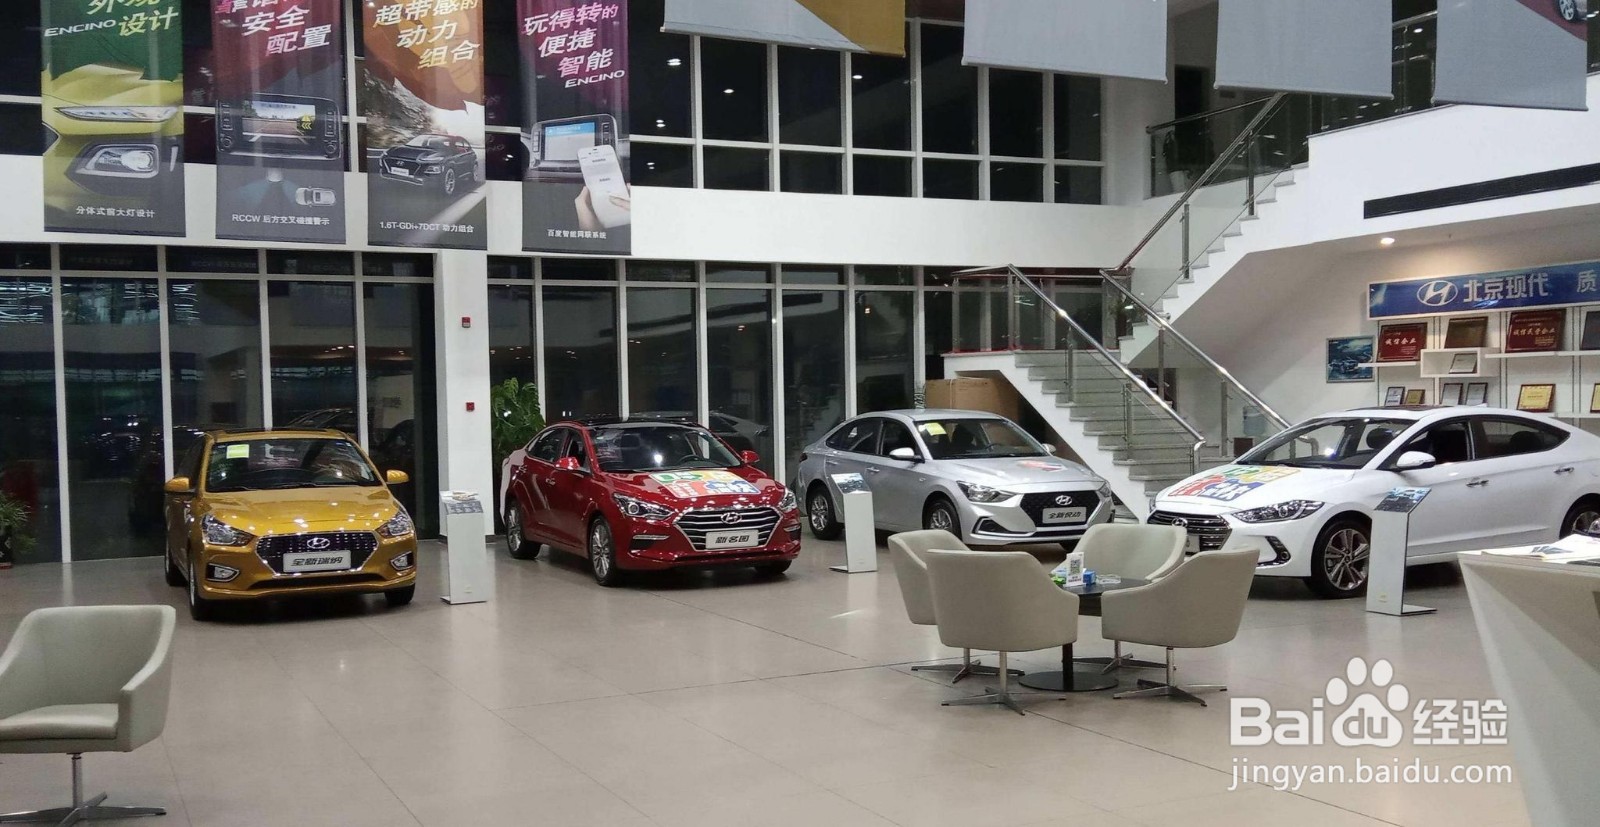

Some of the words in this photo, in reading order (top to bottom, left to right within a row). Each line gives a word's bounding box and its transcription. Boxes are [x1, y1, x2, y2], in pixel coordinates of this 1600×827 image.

[44, 19, 117, 37] ENCINO
[118, 6, 179, 36] 设计
[241, 4, 310, 37] 安全
[522, 2, 619, 36] 玩得转的
[265, 24, 332, 56] 配置
[396, 20, 458, 48] 动力
[538, 27, 598, 58] 便捷
[417, 40, 481, 69] 组合
[558, 48, 614, 78] 智能
[564, 70, 625, 89] ENCINO
[76, 205, 156, 219] 分体式前大灯设计
[232, 213, 261, 223] RCCW
[442, 223, 475, 234] 动力组合
[547, 228, 607, 240] 百度智能网联系统
[1463, 272, 1549, 303] 北京现代
[1576, 269, 1598, 293] 质
